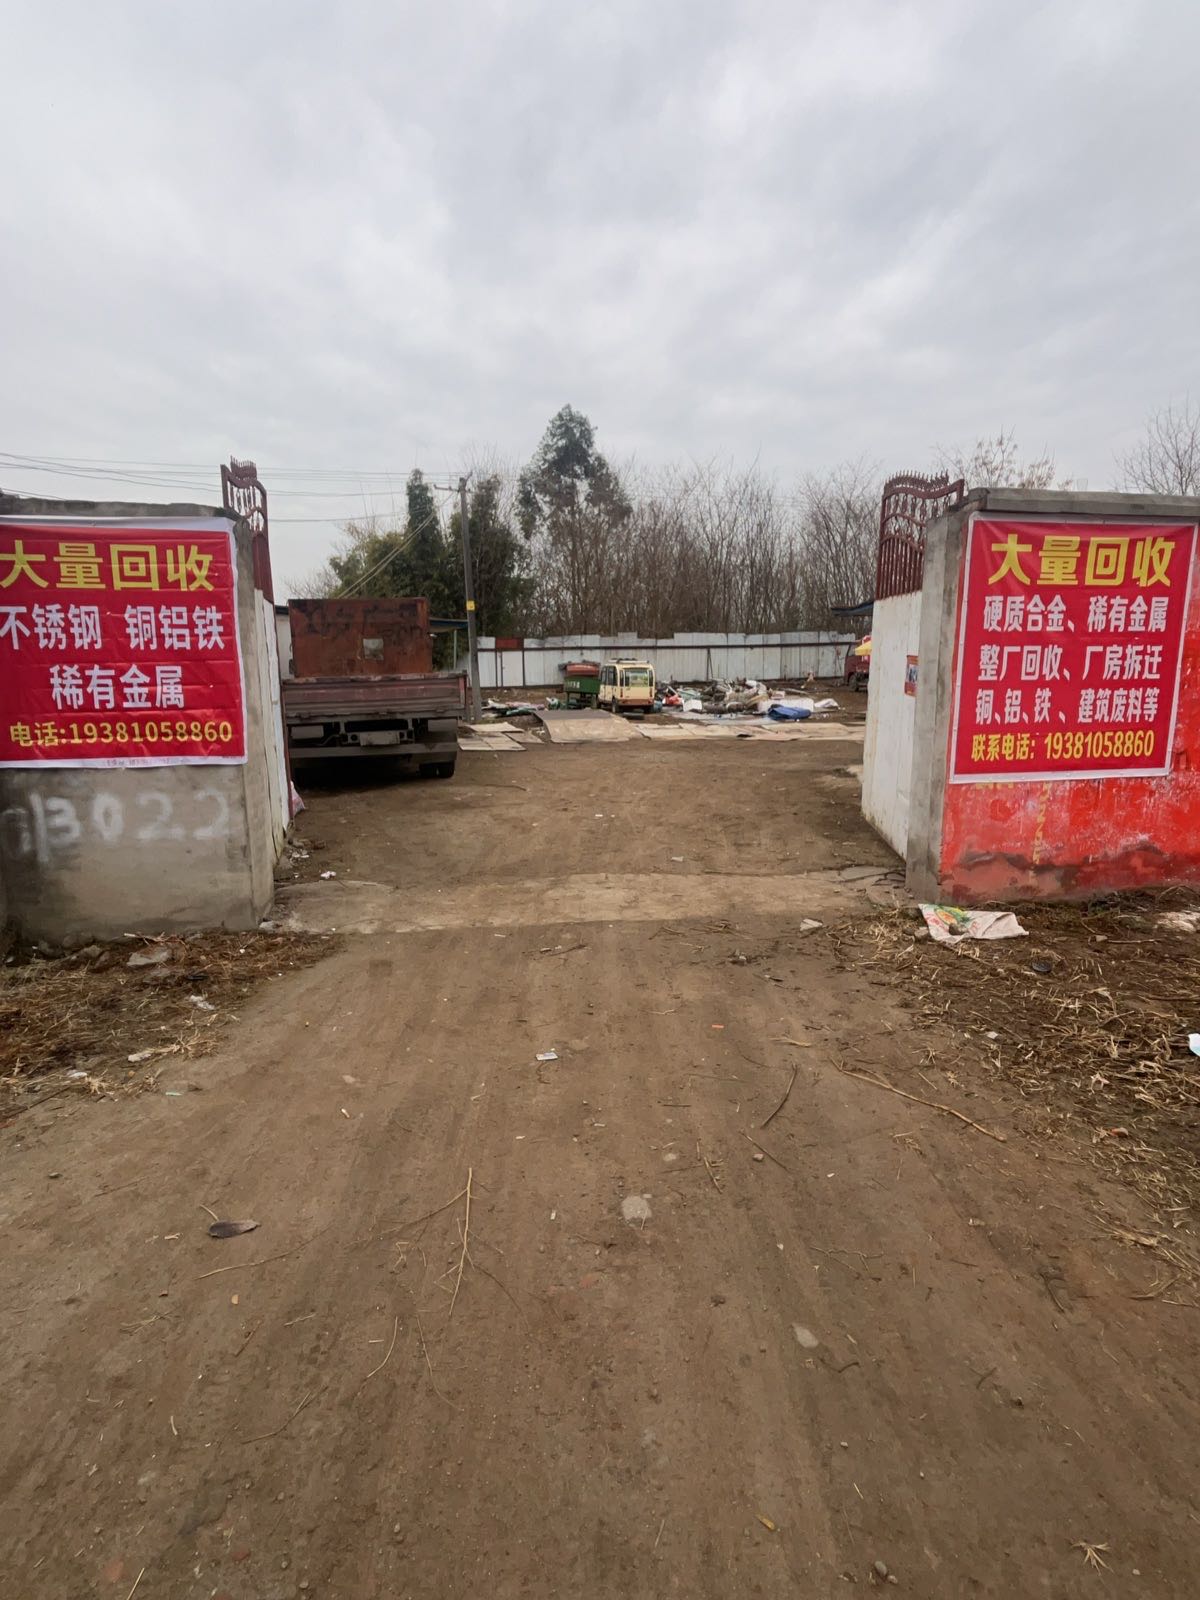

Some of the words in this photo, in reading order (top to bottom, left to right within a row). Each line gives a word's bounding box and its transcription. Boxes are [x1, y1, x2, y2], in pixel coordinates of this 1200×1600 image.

[0, 539, 214, 592] 大量回收
[988, 533, 1175, 588] 大量回收
[0, 603, 102, 650] 不锈钢
[124, 604, 225, 650] 铜铝铁
[49, 664, 185, 709] 稀有金属
